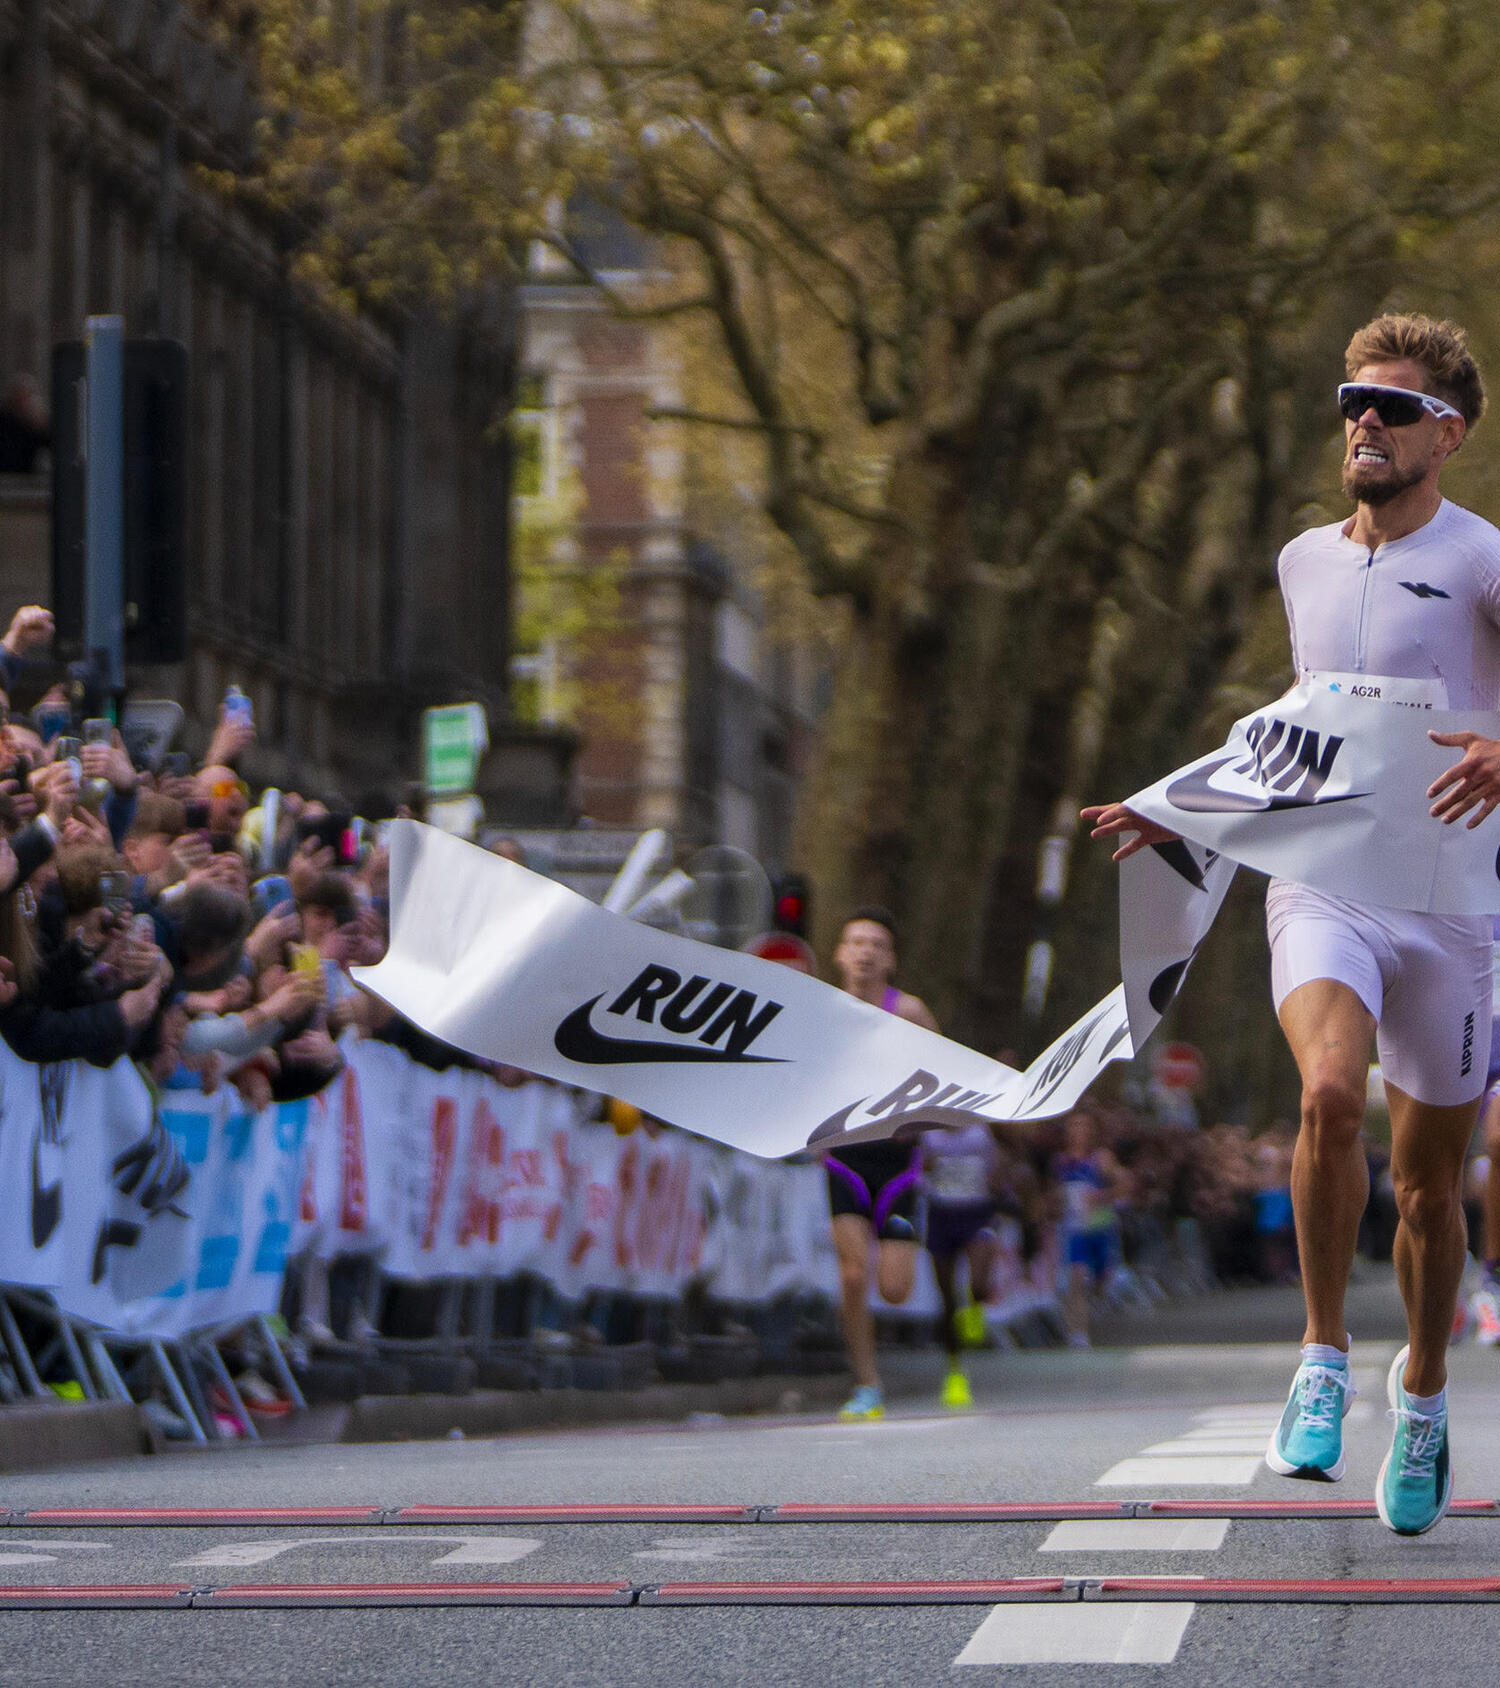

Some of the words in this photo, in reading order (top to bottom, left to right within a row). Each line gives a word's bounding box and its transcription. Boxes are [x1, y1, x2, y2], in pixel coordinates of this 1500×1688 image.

[1350, 685, 1382, 699] AG2R
[1233, 716, 1345, 801] RUN
[606, 963, 784, 1054] RUN
[1460, 1010, 1475, 1077] KIPRUN
